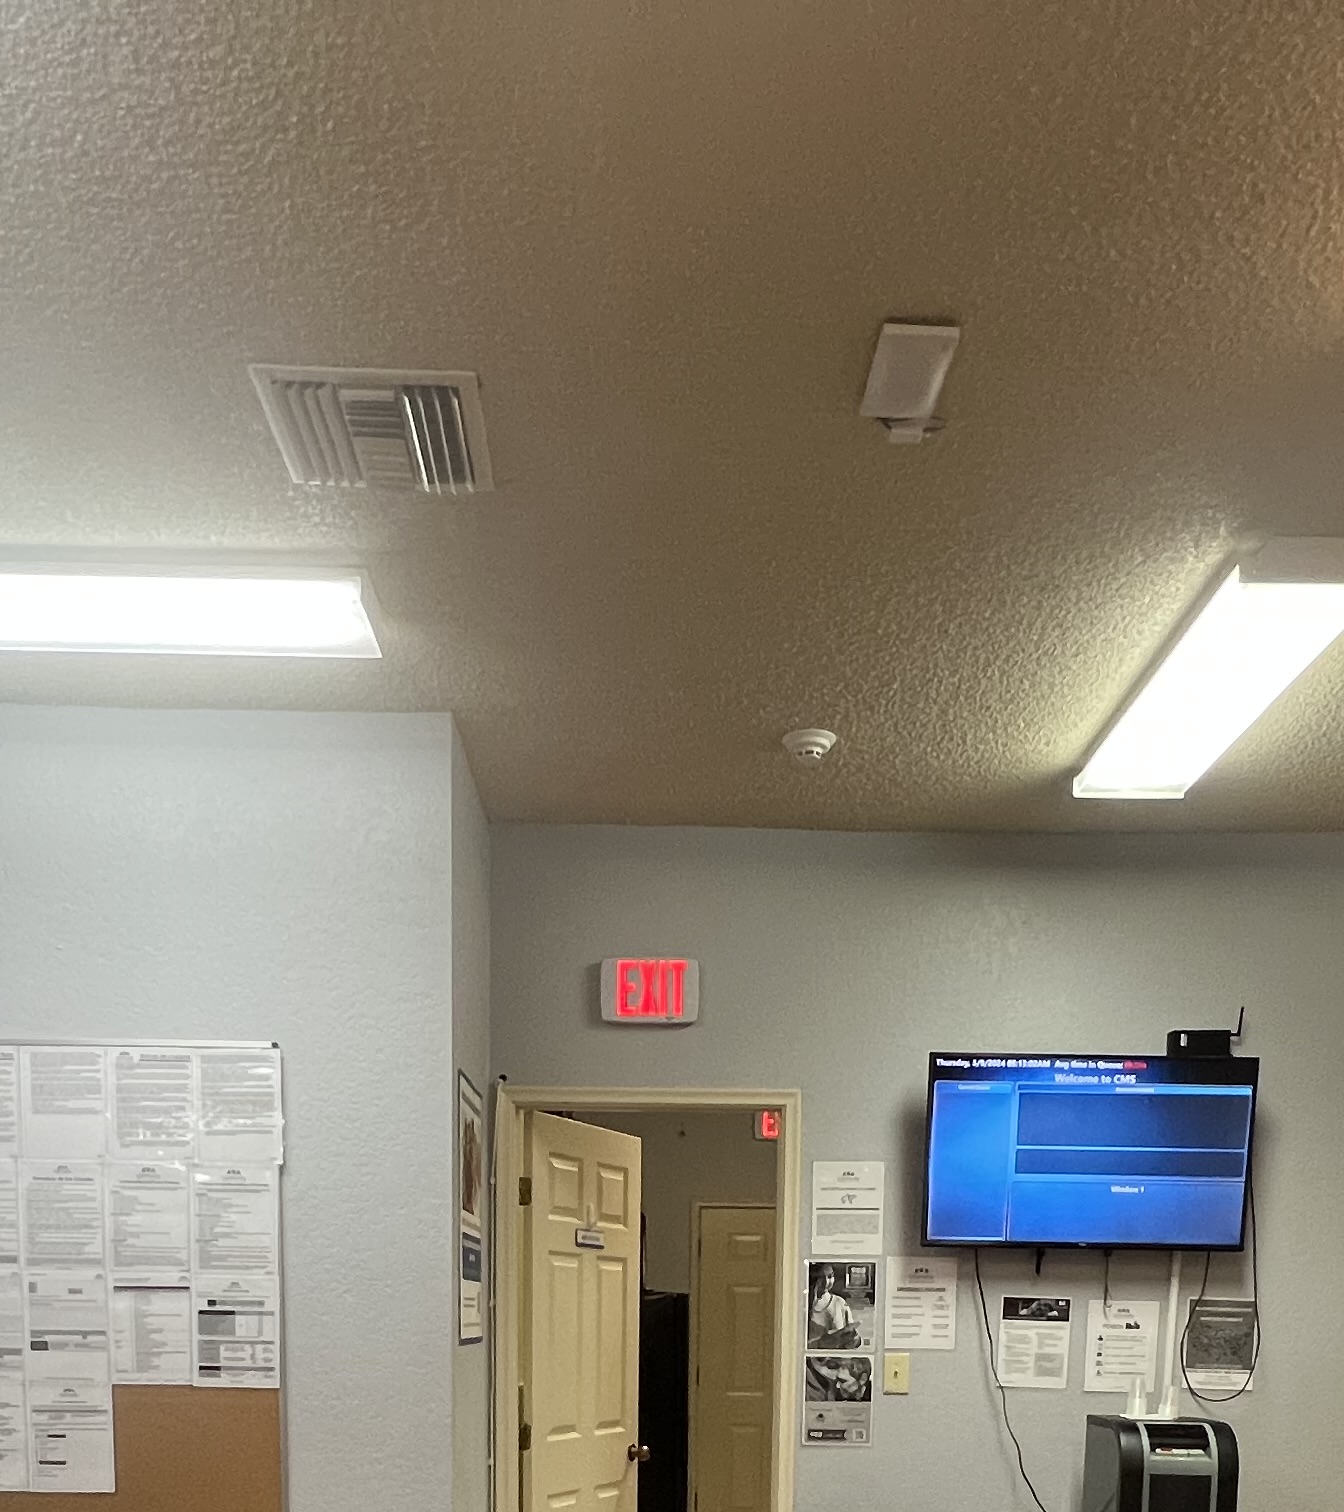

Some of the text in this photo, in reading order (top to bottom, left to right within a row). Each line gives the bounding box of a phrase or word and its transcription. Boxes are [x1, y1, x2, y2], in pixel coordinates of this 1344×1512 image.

[616, 959, 688, 1017] EXIT
[1054, 1073, 1137, 1084] Welcome to CMS
